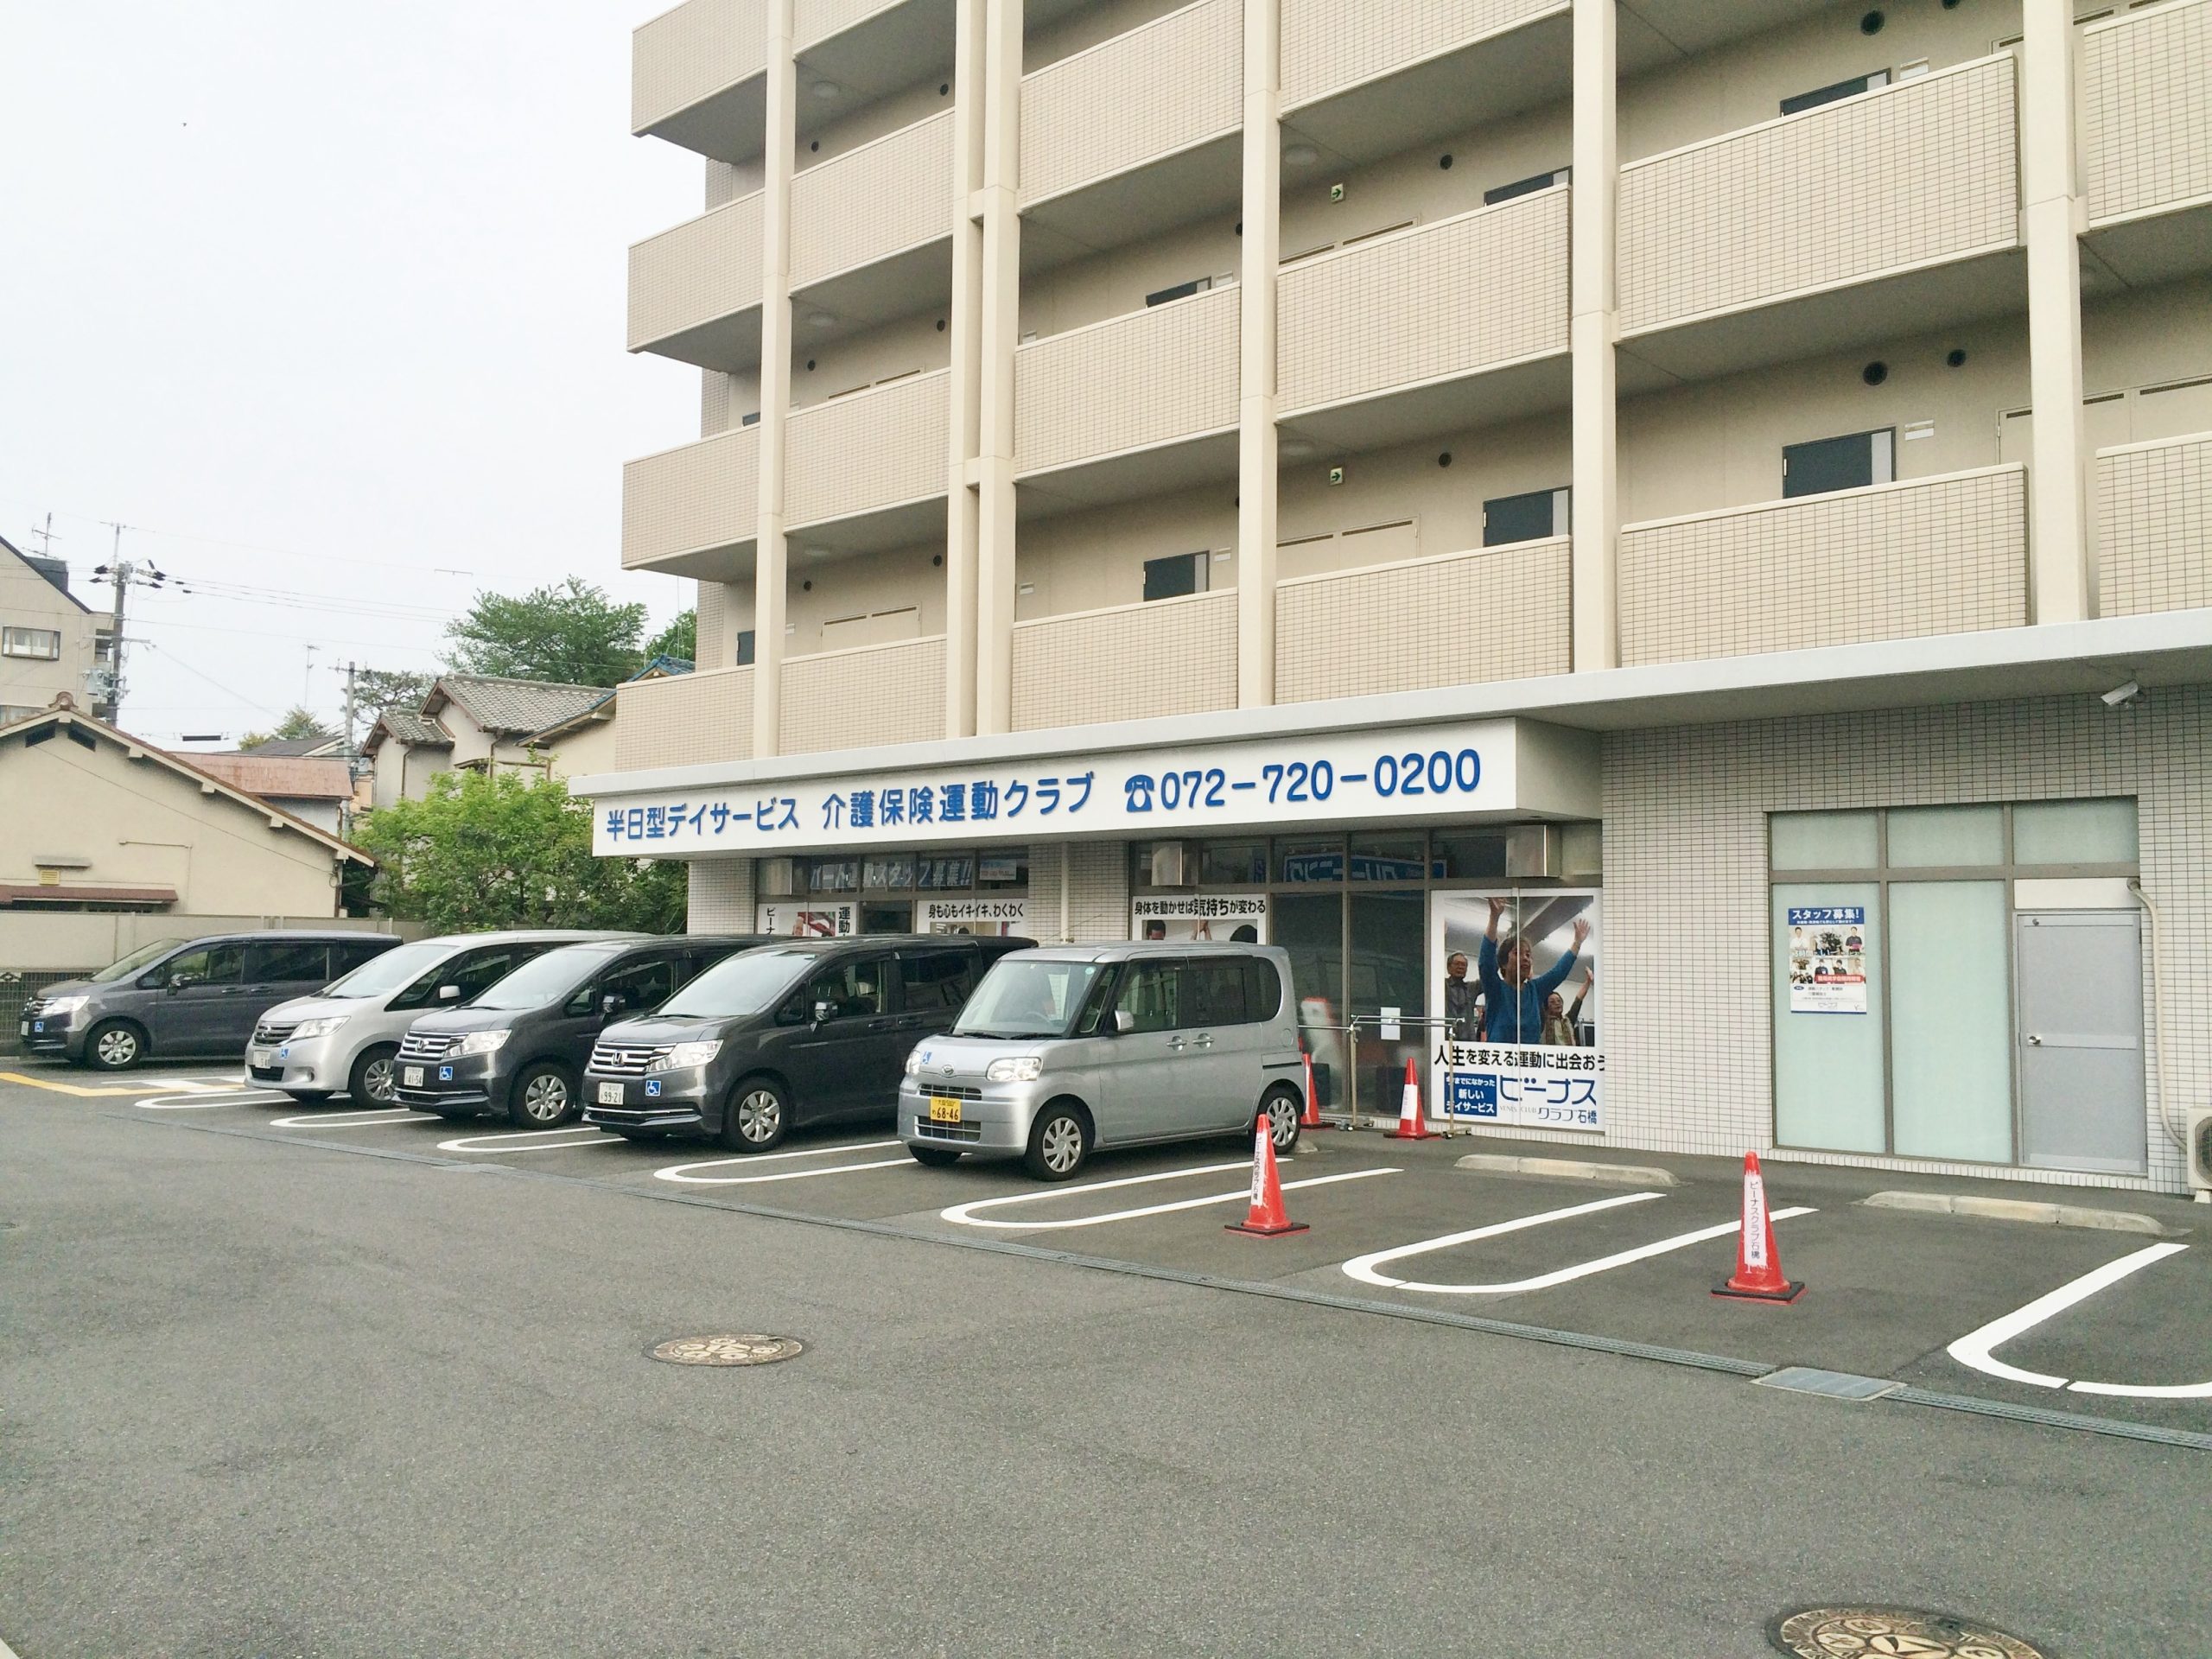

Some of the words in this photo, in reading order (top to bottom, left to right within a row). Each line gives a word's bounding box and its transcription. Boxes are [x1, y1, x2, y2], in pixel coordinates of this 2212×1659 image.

[607, 798, 800, 842] 半日型デイサービス
[822, 771, 1096, 829] 介護保険運動クラブ
[1160, 749, 1481, 810] 072-720-0200
[1135, 898, 1266, 917] 身体を動かせば気持ちが変わる
[1792, 908, 1859, 920] スタッフ募集!
[839, 906, 851, 936] 運動
[1459, 1089, 1484, 1100] 新しい
[1500, 1074, 1597, 1106] ビーナス
[937, 1107, 959, 1121] 68-46
[1750, 1181, 1760, 1259] ビーナスクラブ石橋
